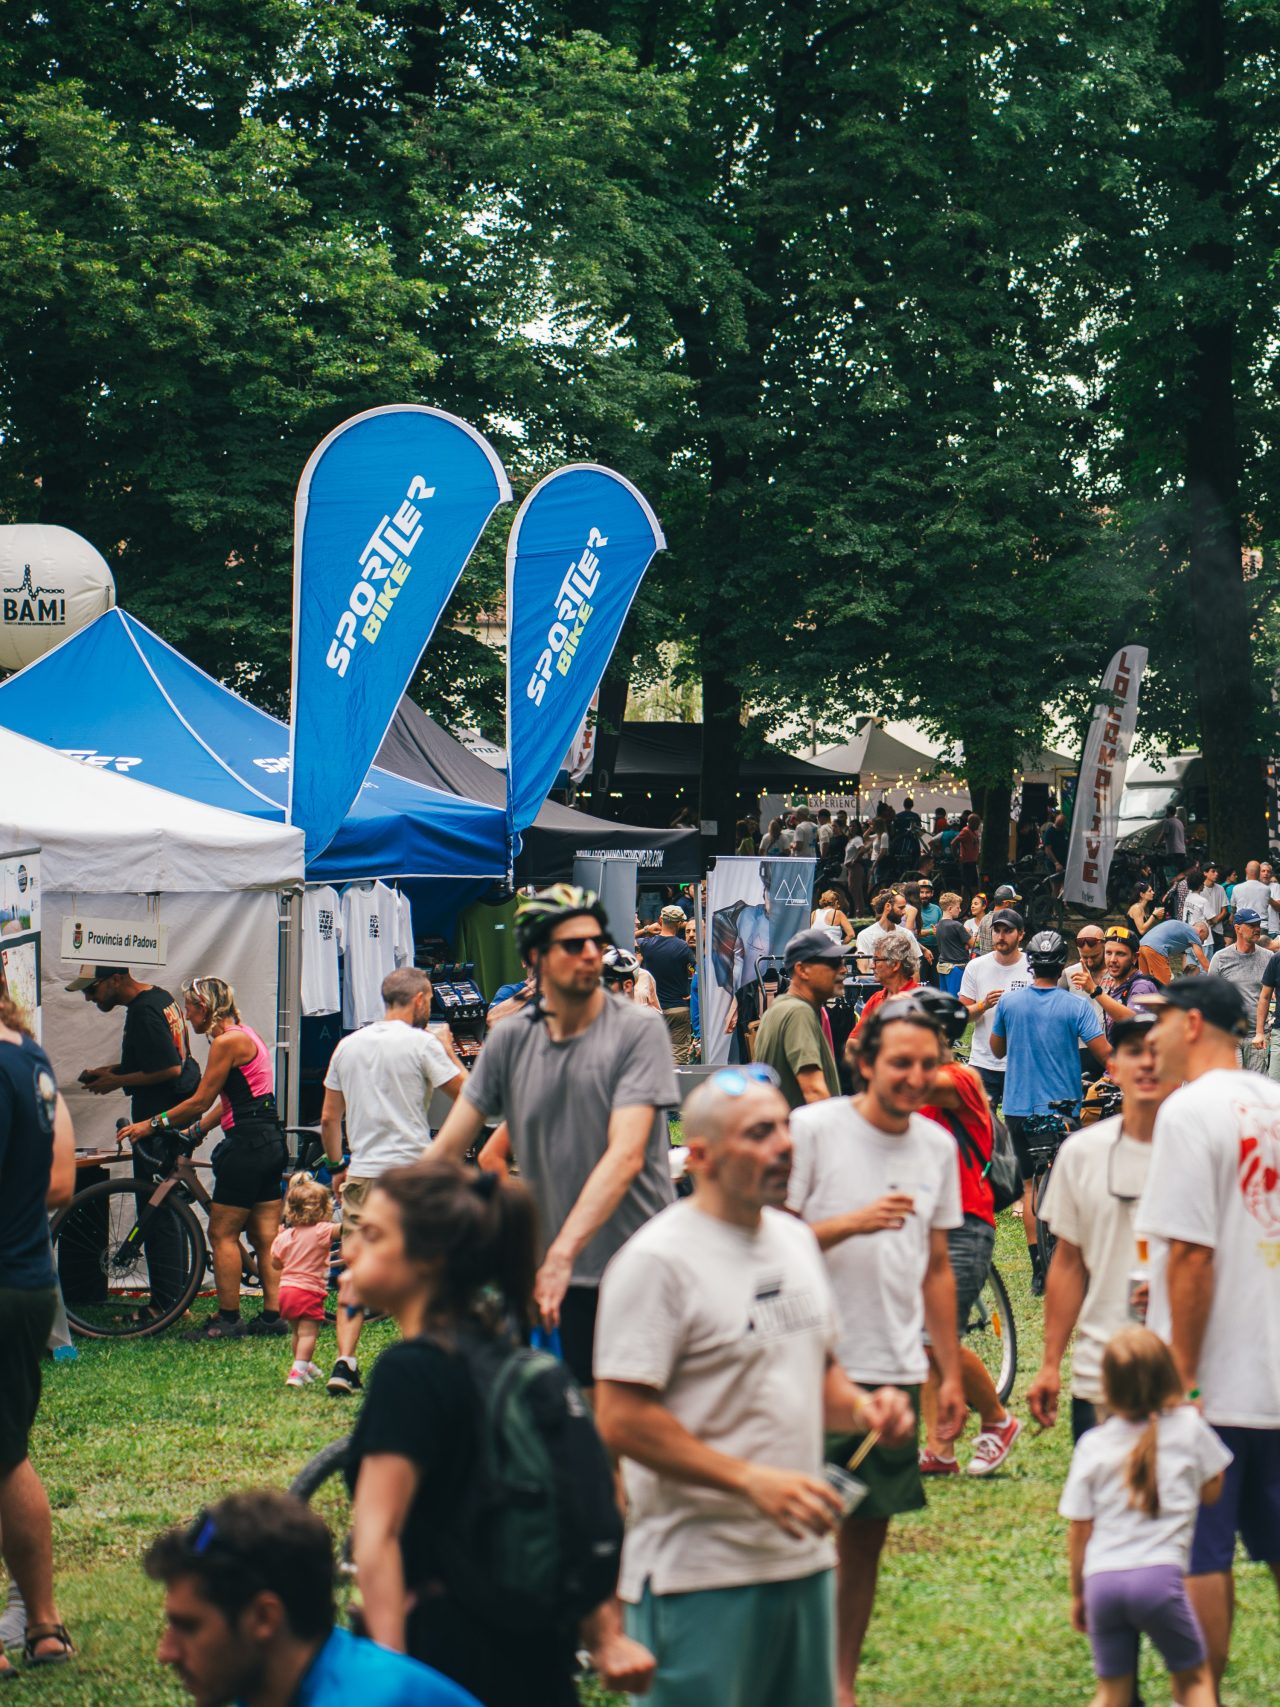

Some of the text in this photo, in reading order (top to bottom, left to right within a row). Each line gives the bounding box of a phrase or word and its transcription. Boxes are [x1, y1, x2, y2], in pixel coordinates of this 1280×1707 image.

[3, 598, 66, 622] BAM!
[325, 475, 436, 678] SPORTLER
[361, 558, 412, 644] BIKE
[526, 527, 609, 706] SPORTLER
[556, 600, 594, 677] BIKE
[808, 798, 857, 809] EXPERIENC
[1082, 651, 1131, 884] LOCOMOTIVE
[88, 931, 157, 949] Provincia di Padova
